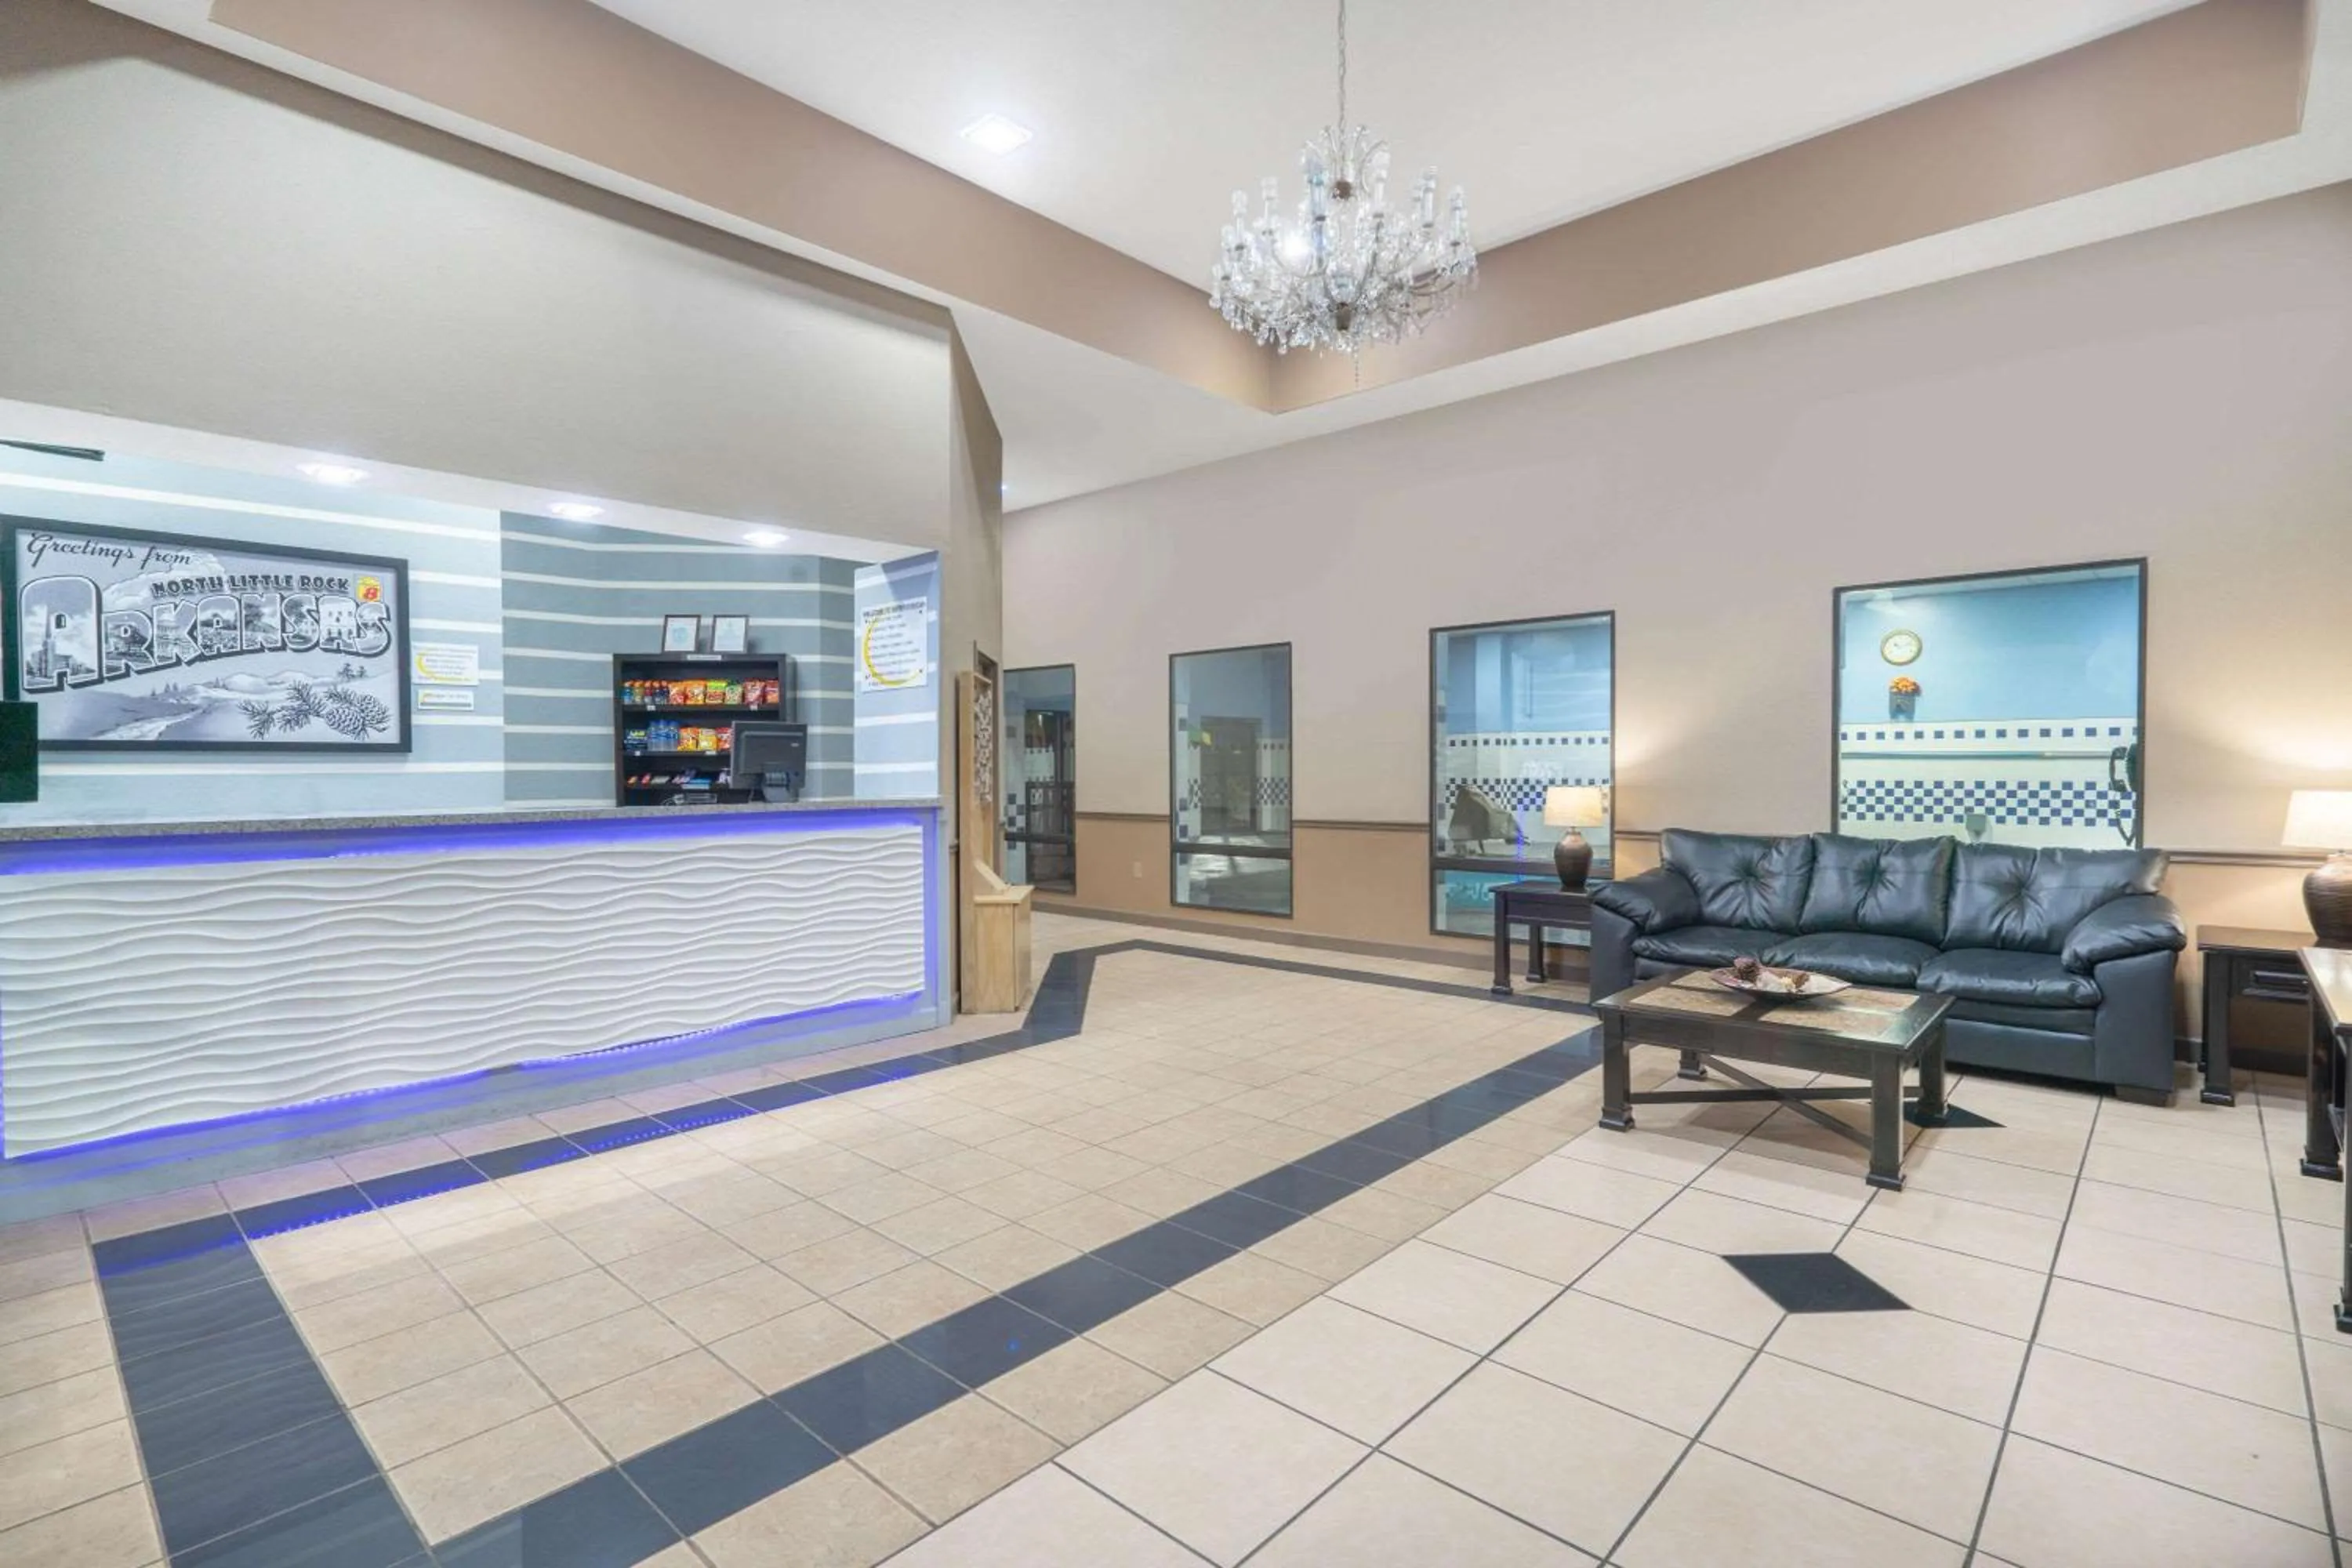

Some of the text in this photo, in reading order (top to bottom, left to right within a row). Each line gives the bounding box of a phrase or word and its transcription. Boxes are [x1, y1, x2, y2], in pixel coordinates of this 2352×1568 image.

[27, 532, 191, 570] Greetings from
[151, 574, 350, 597] NORTH LITTLE ROCK
[20, 575, 391, 691] ARKANSAS
